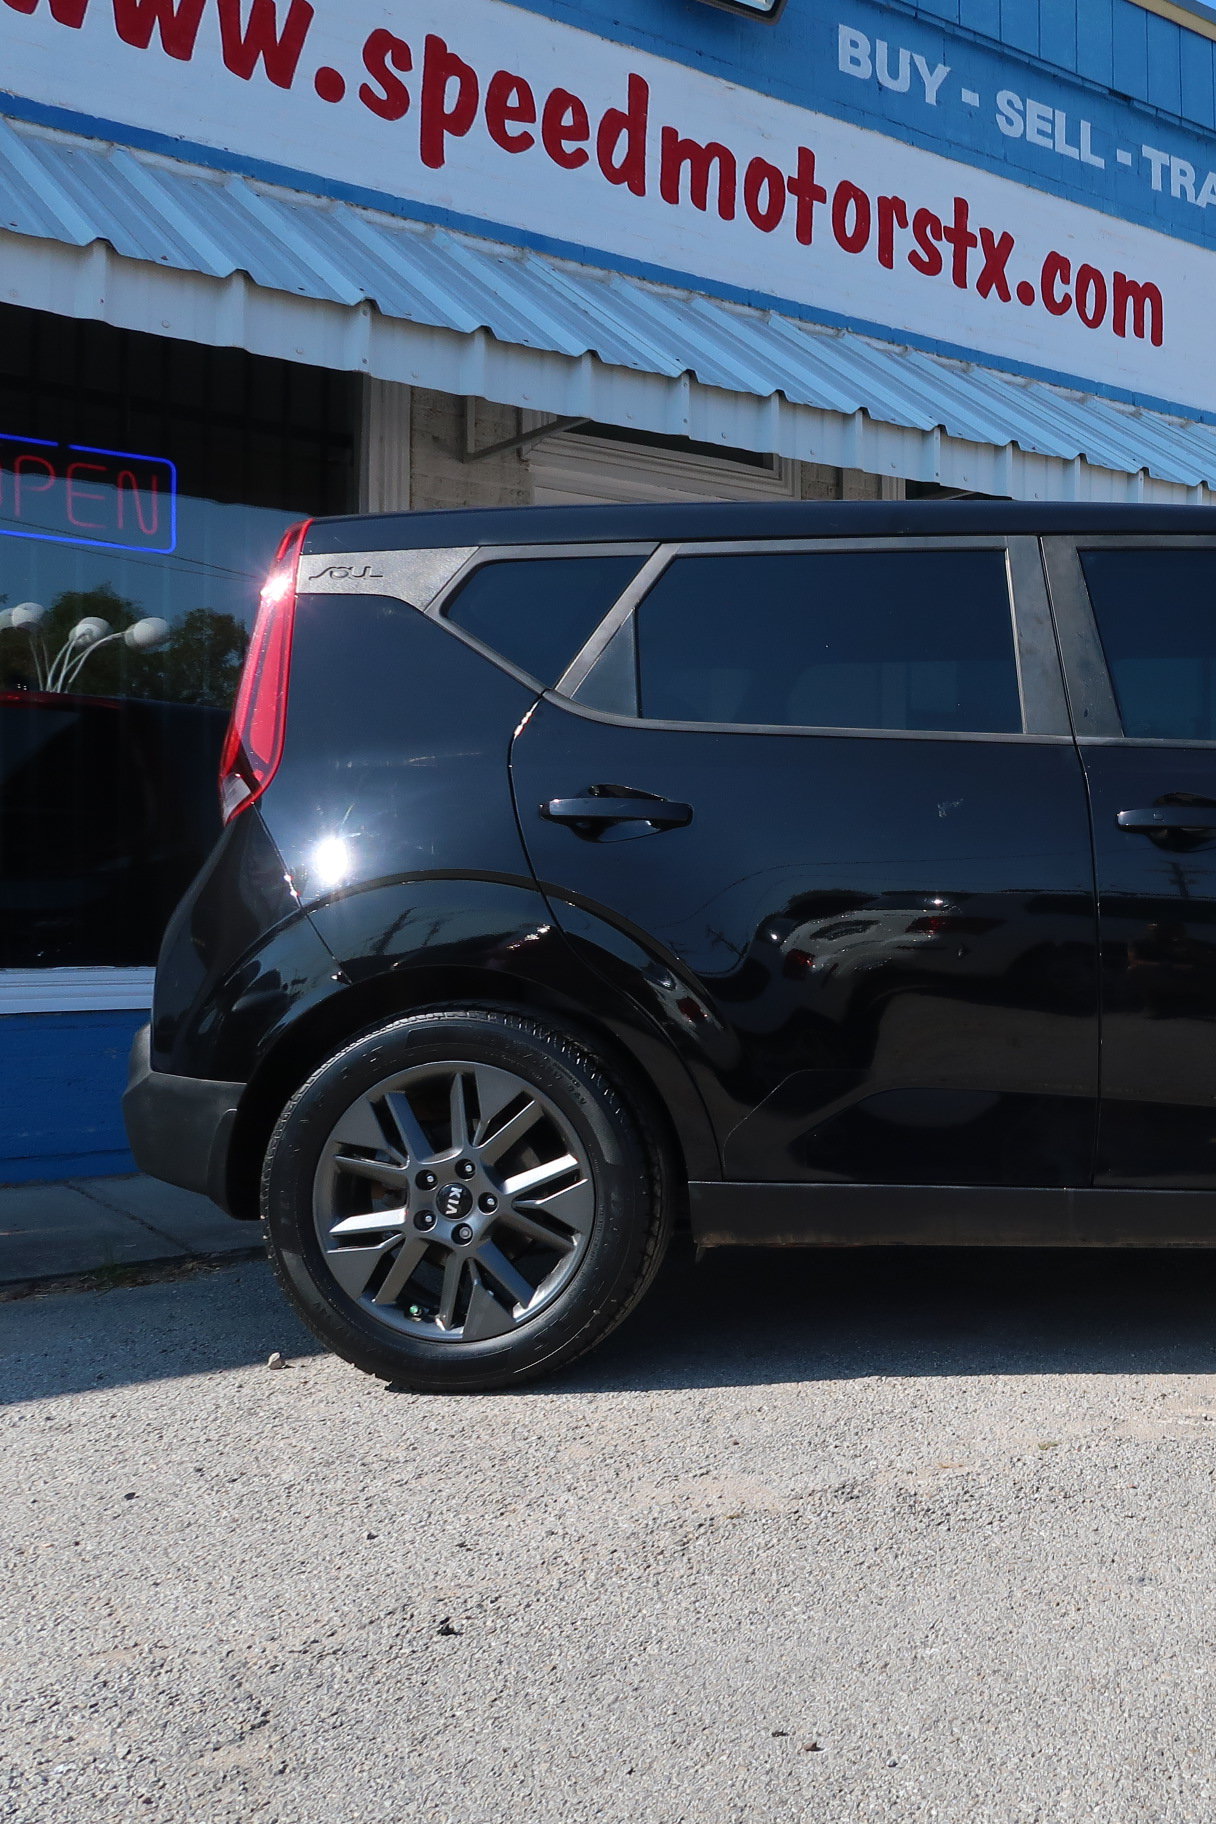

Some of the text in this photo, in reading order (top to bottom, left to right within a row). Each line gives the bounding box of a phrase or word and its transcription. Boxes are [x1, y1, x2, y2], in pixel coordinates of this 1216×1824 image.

[837, 23, 951, 107] BUY
[995, 89, 1105, 169] SELL
[0, 454, 159, 536] PEN
[308, 565, 384, 581] SOUL
[445, 1187, 463, 1215] KIA
